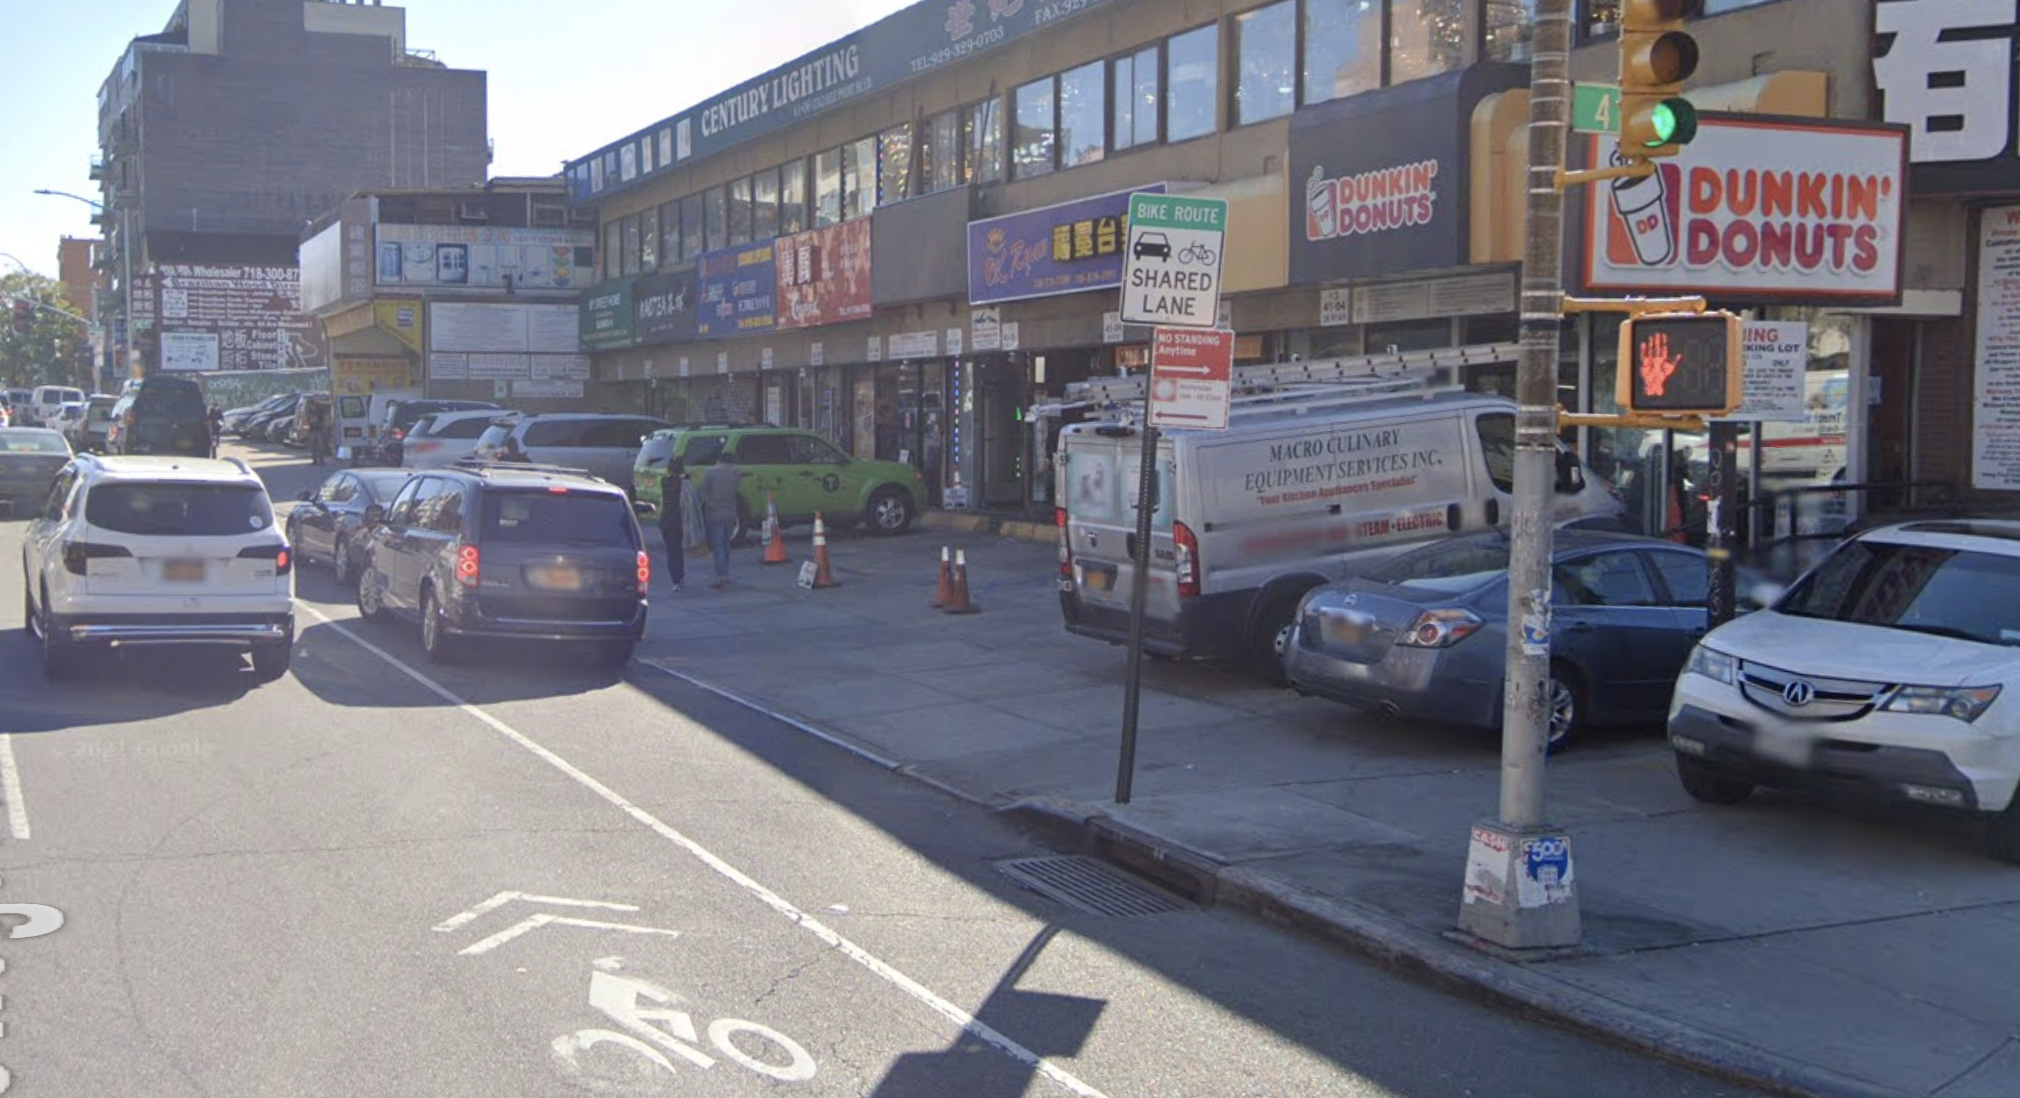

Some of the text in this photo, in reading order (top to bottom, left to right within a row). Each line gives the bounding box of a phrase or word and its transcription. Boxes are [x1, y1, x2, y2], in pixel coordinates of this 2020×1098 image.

[701, 44, 859, 137] CENTURY LIGHTING
[1340, 159, 1438, 204] DUNKIN'
[1689, 167, 1891, 221] DUNKIN'
[1137, 203, 1219, 224] BIKE ROUTE
[1339, 195, 1433, 235] DONUTS
[1636, 214, 1659, 235] DD
[1687, 218, 1879, 272] DONUTS
[193, 265, 241, 278] Wholesaler
[1131, 269, 1212, 291] SHARED
[1143, 296, 1196, 316] LANE
[252, 330, 277, 339] Floor
[1159, 334, 1220, 346] NO STANDING
[1159, 345, 1197, 356] Anytime
[1778, 344, 1800, 353] LOT
[1270, 428, 1401, 462] MACRO CULINARY
[1244, 449, 1443, 492] EQUIPMENT SERVICES INC.
[1281, 489, 1317, 503] Kitchen
[1318, 483, 1369, 499] Appliances
[1396, 512, 1444, 532] ELECTRIC
